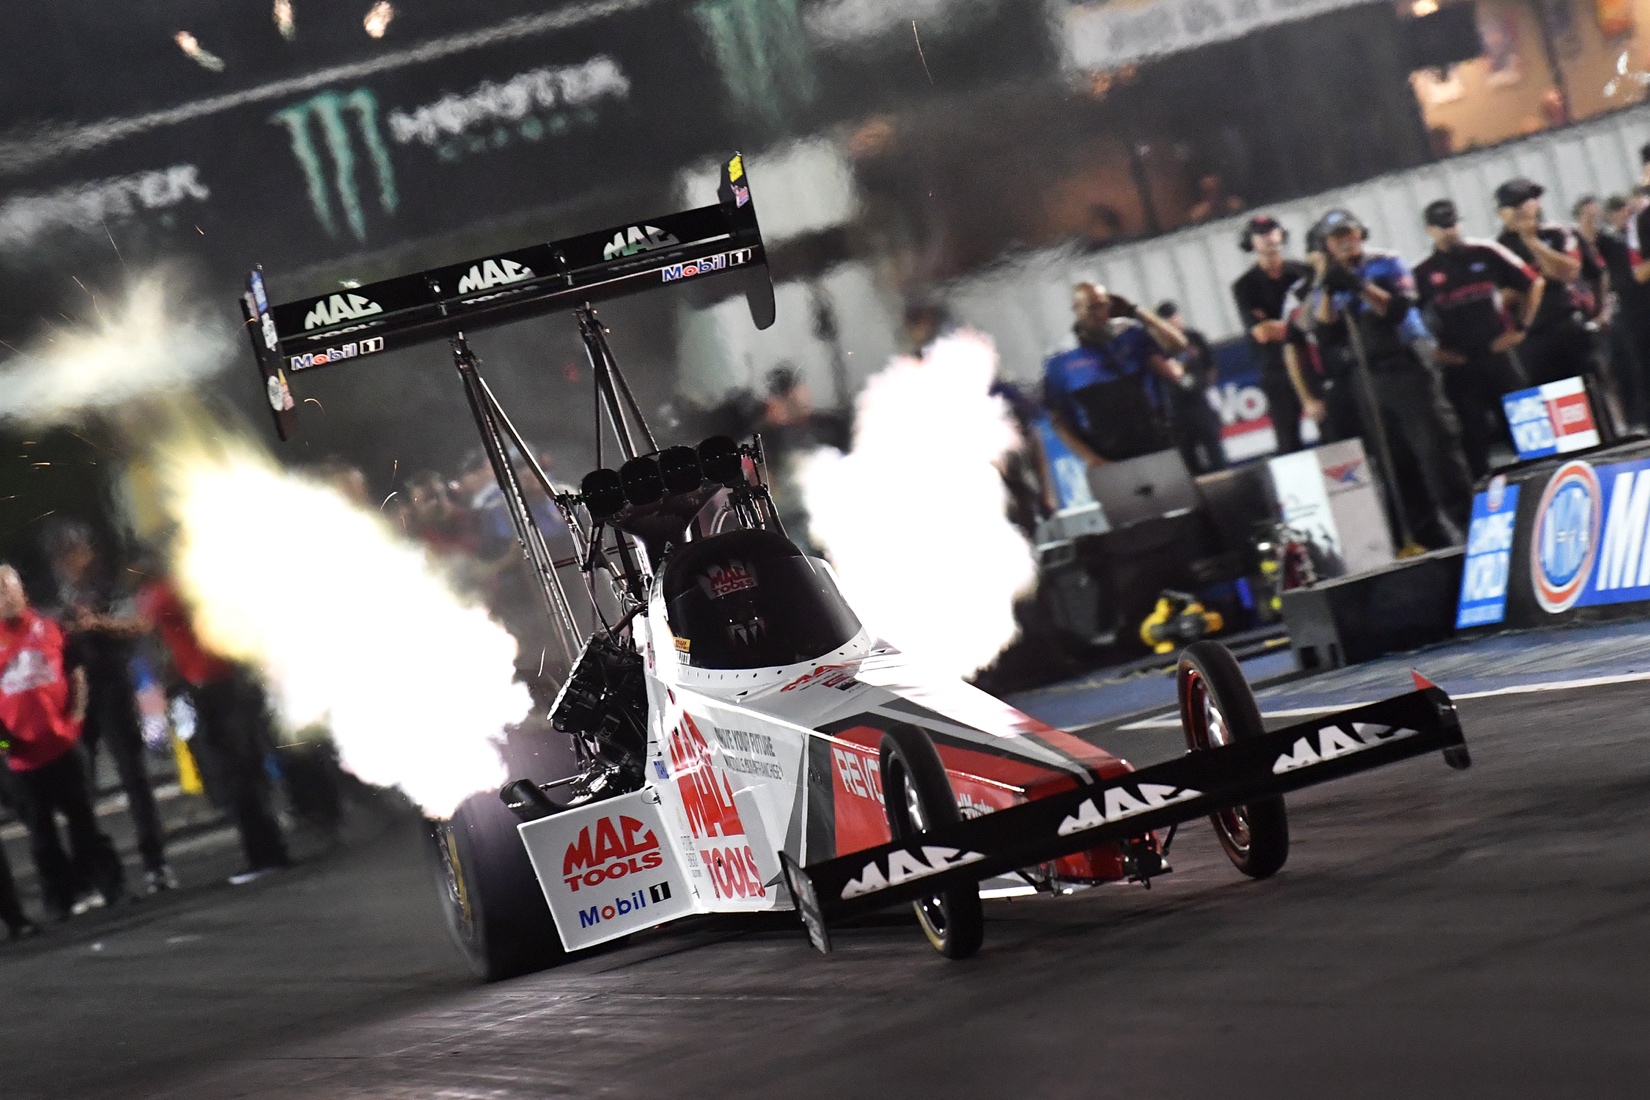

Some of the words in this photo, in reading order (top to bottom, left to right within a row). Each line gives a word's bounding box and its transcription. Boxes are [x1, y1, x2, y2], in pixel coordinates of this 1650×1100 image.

[603, 224, 681, 261] MAC
[458, 258, 536, 295] MAC
[661, 254, 725, 283] Mobil
[304, 293, 384, 330] MAC
[291, 342, 358, 371] Mobil
[710, 560, 755, 588] MAC
[712, 577, 755, 597] TOOLS
[749, 732, 776, 758] FUTURE
[1272, 722, 1421, 775] MAC
[832, 747, 886, 805] REVC
[1057, 783, 1208, 837] MAC
[563, 815, 660, 876] MAC
[564, 851, 663, 892] TOOLS
[700, 845, 766, 899] TOOLS
[841, 845, 990, 900] MAC
[579, 889, 646, 929] Mobil
[651, 882, 670, 903] 1
